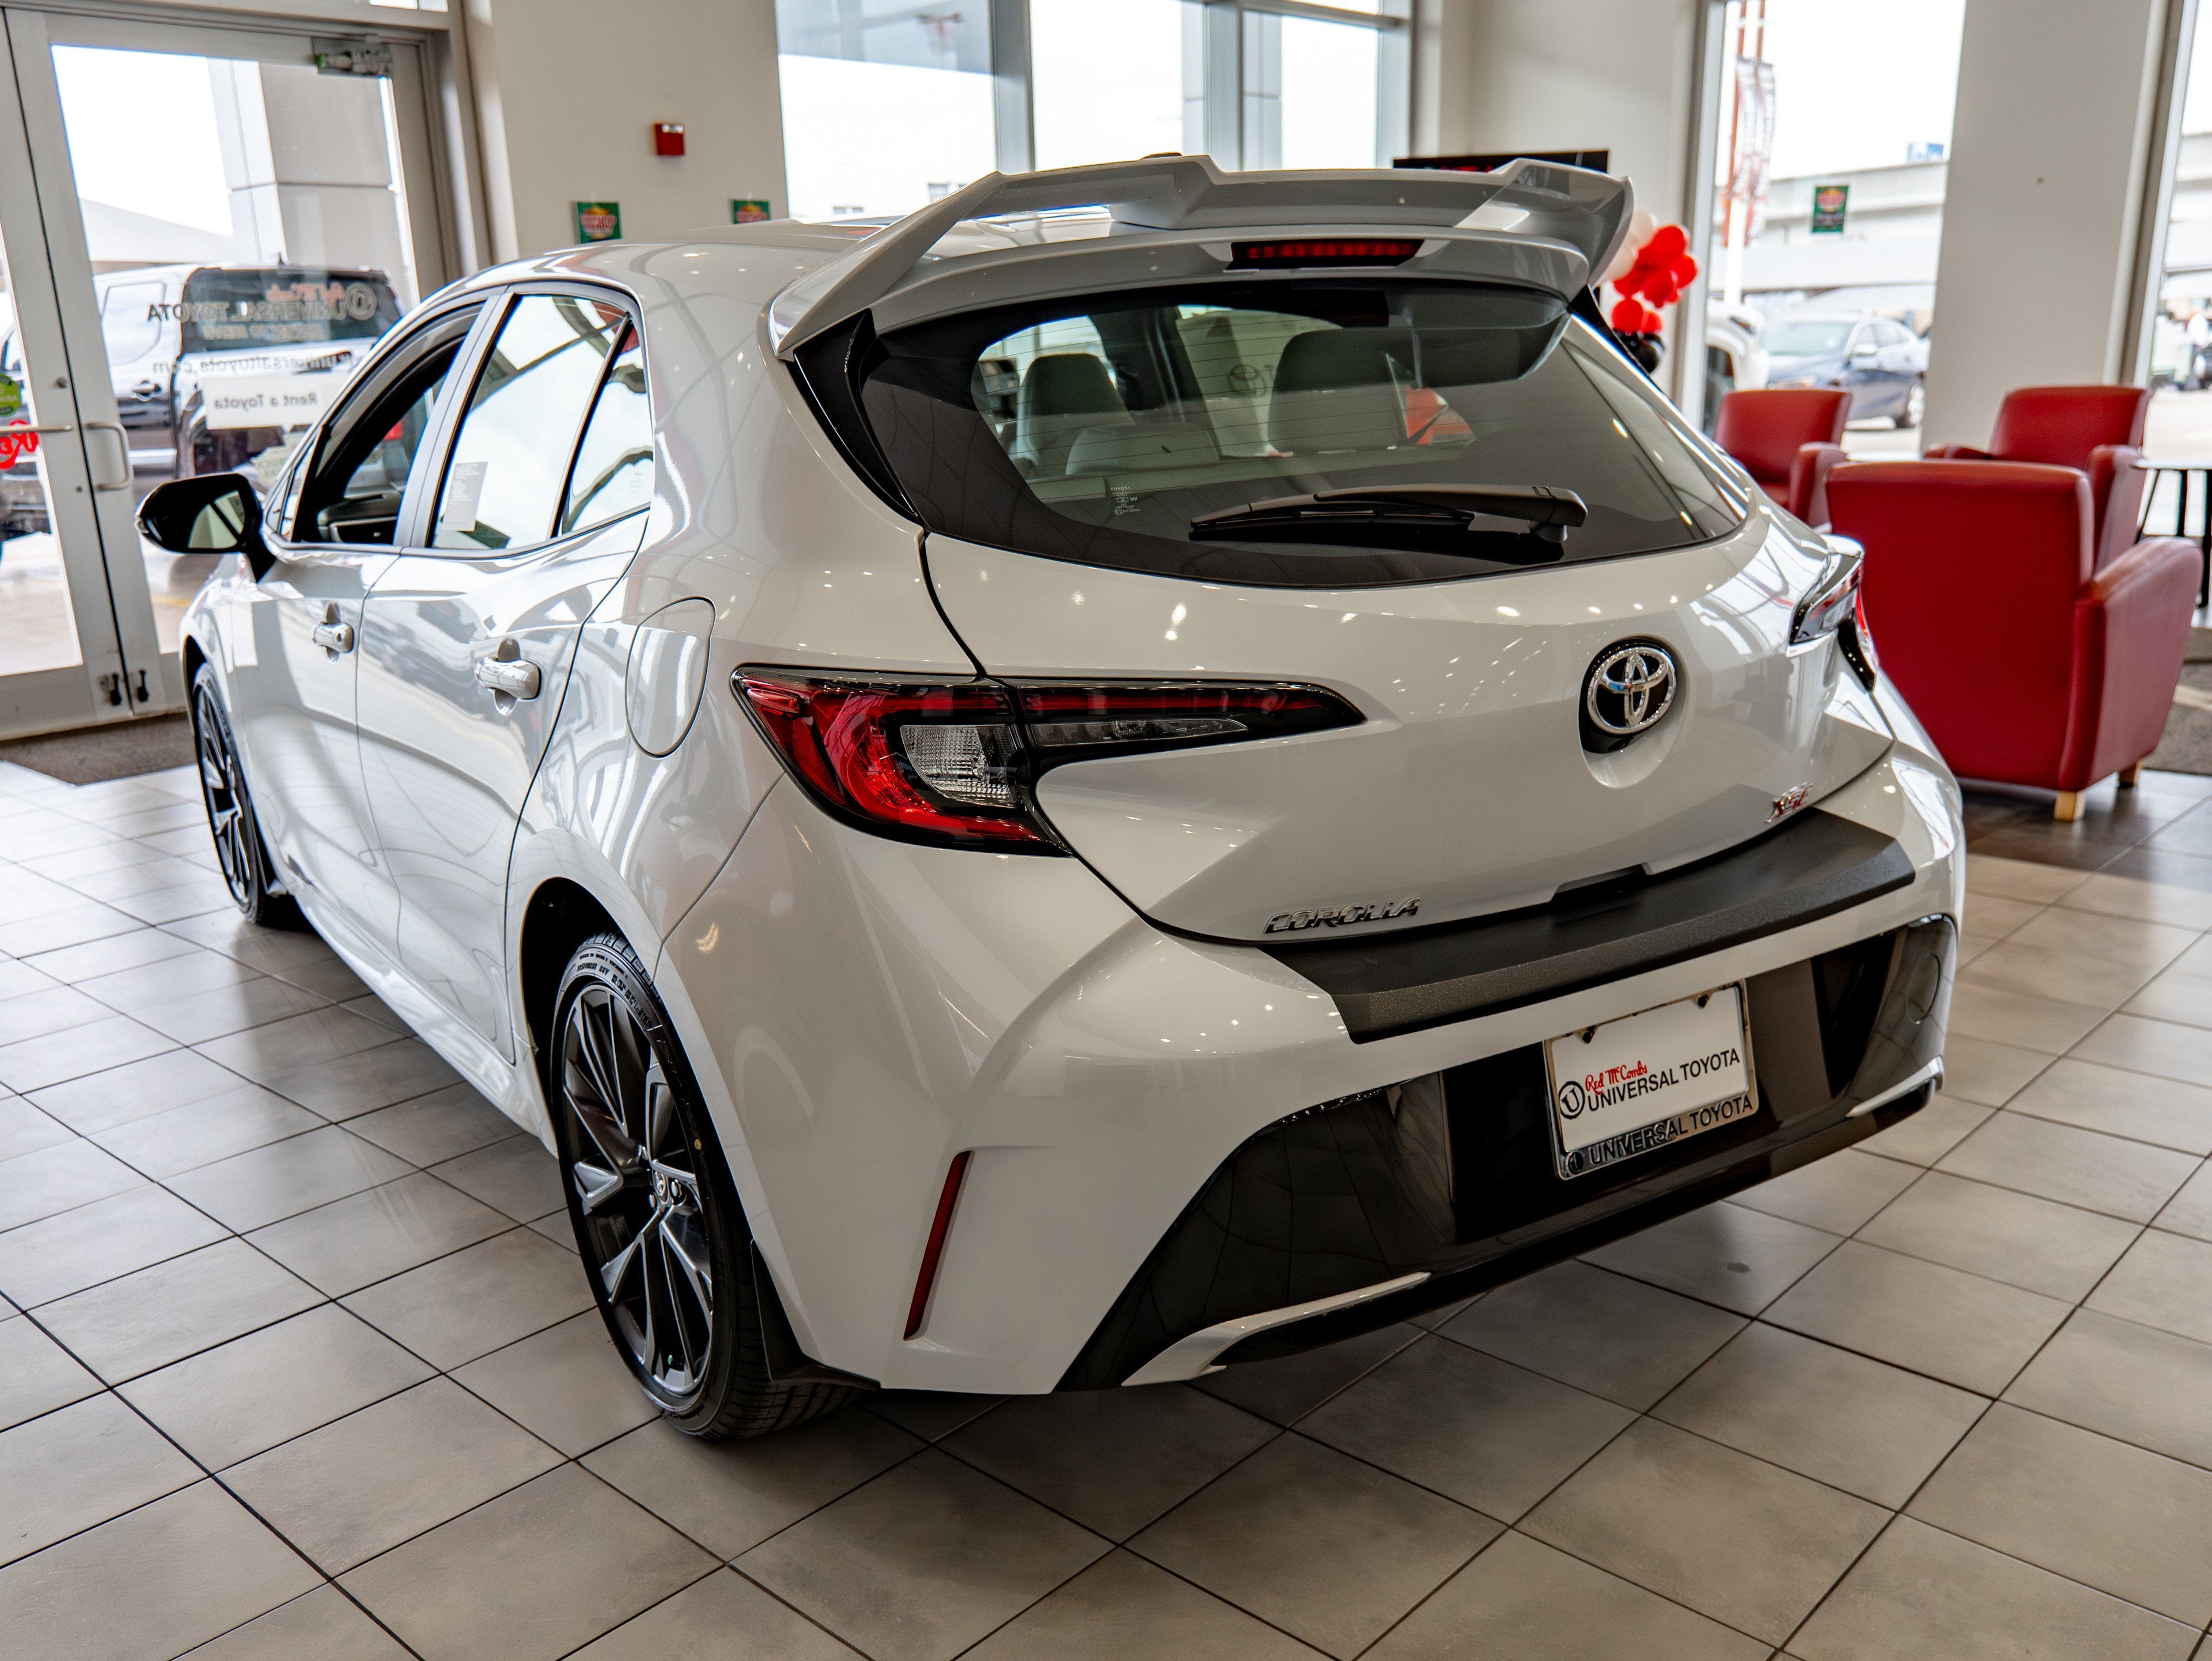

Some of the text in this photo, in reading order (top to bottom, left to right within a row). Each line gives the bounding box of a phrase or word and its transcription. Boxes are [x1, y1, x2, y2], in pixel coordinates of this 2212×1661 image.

[1263, 896, 1421, 934] COROLLA
[1585, 1072, 1604, 1095] Red
[1588, 1048, 1740, 1112] UNIVERSAL TOYOTA
[1589, 1117, 1688, 1165] UNIVERSAL
[1689, 1094, 1752, 1130] TOYOTA
